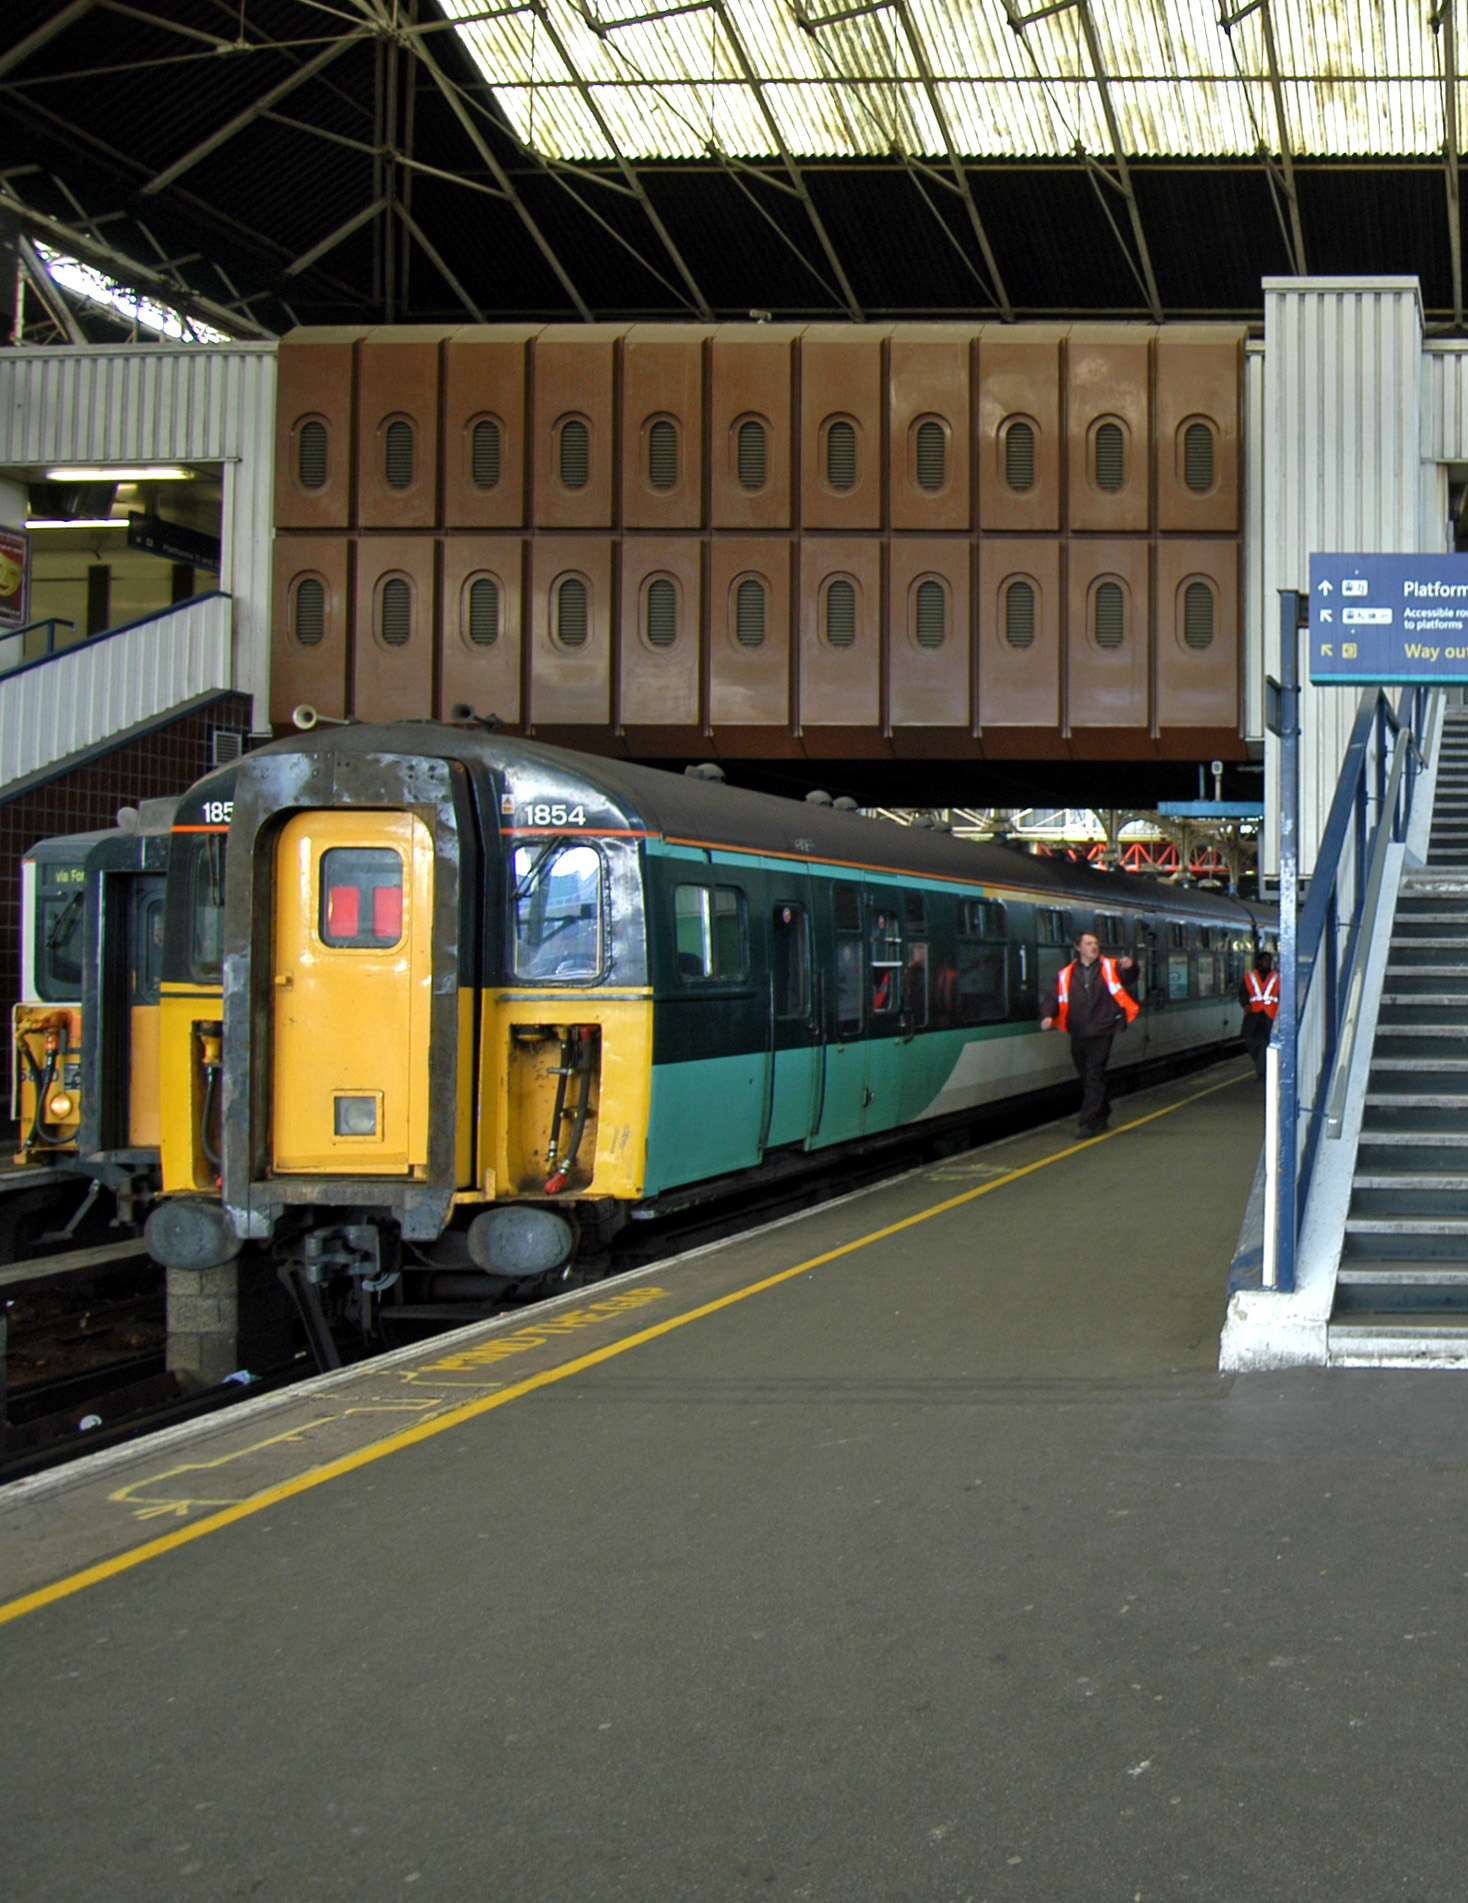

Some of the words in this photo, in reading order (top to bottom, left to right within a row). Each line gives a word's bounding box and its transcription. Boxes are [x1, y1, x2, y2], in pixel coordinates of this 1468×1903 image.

[1404, 607, 1454, 618] Accessible
[1404, 619, 1415, 630] to
[1416, 618, 1463, 632] platforms
[1404, 643, 1440, 662] Way
[524, 804, 587, 826] 1854
[55, 869, 69, 883] via
[418, 1336, 547, 1371] MIND
[511, 1309, 624, 1336] THE
[588, 1286, 673, 1311] GAP
